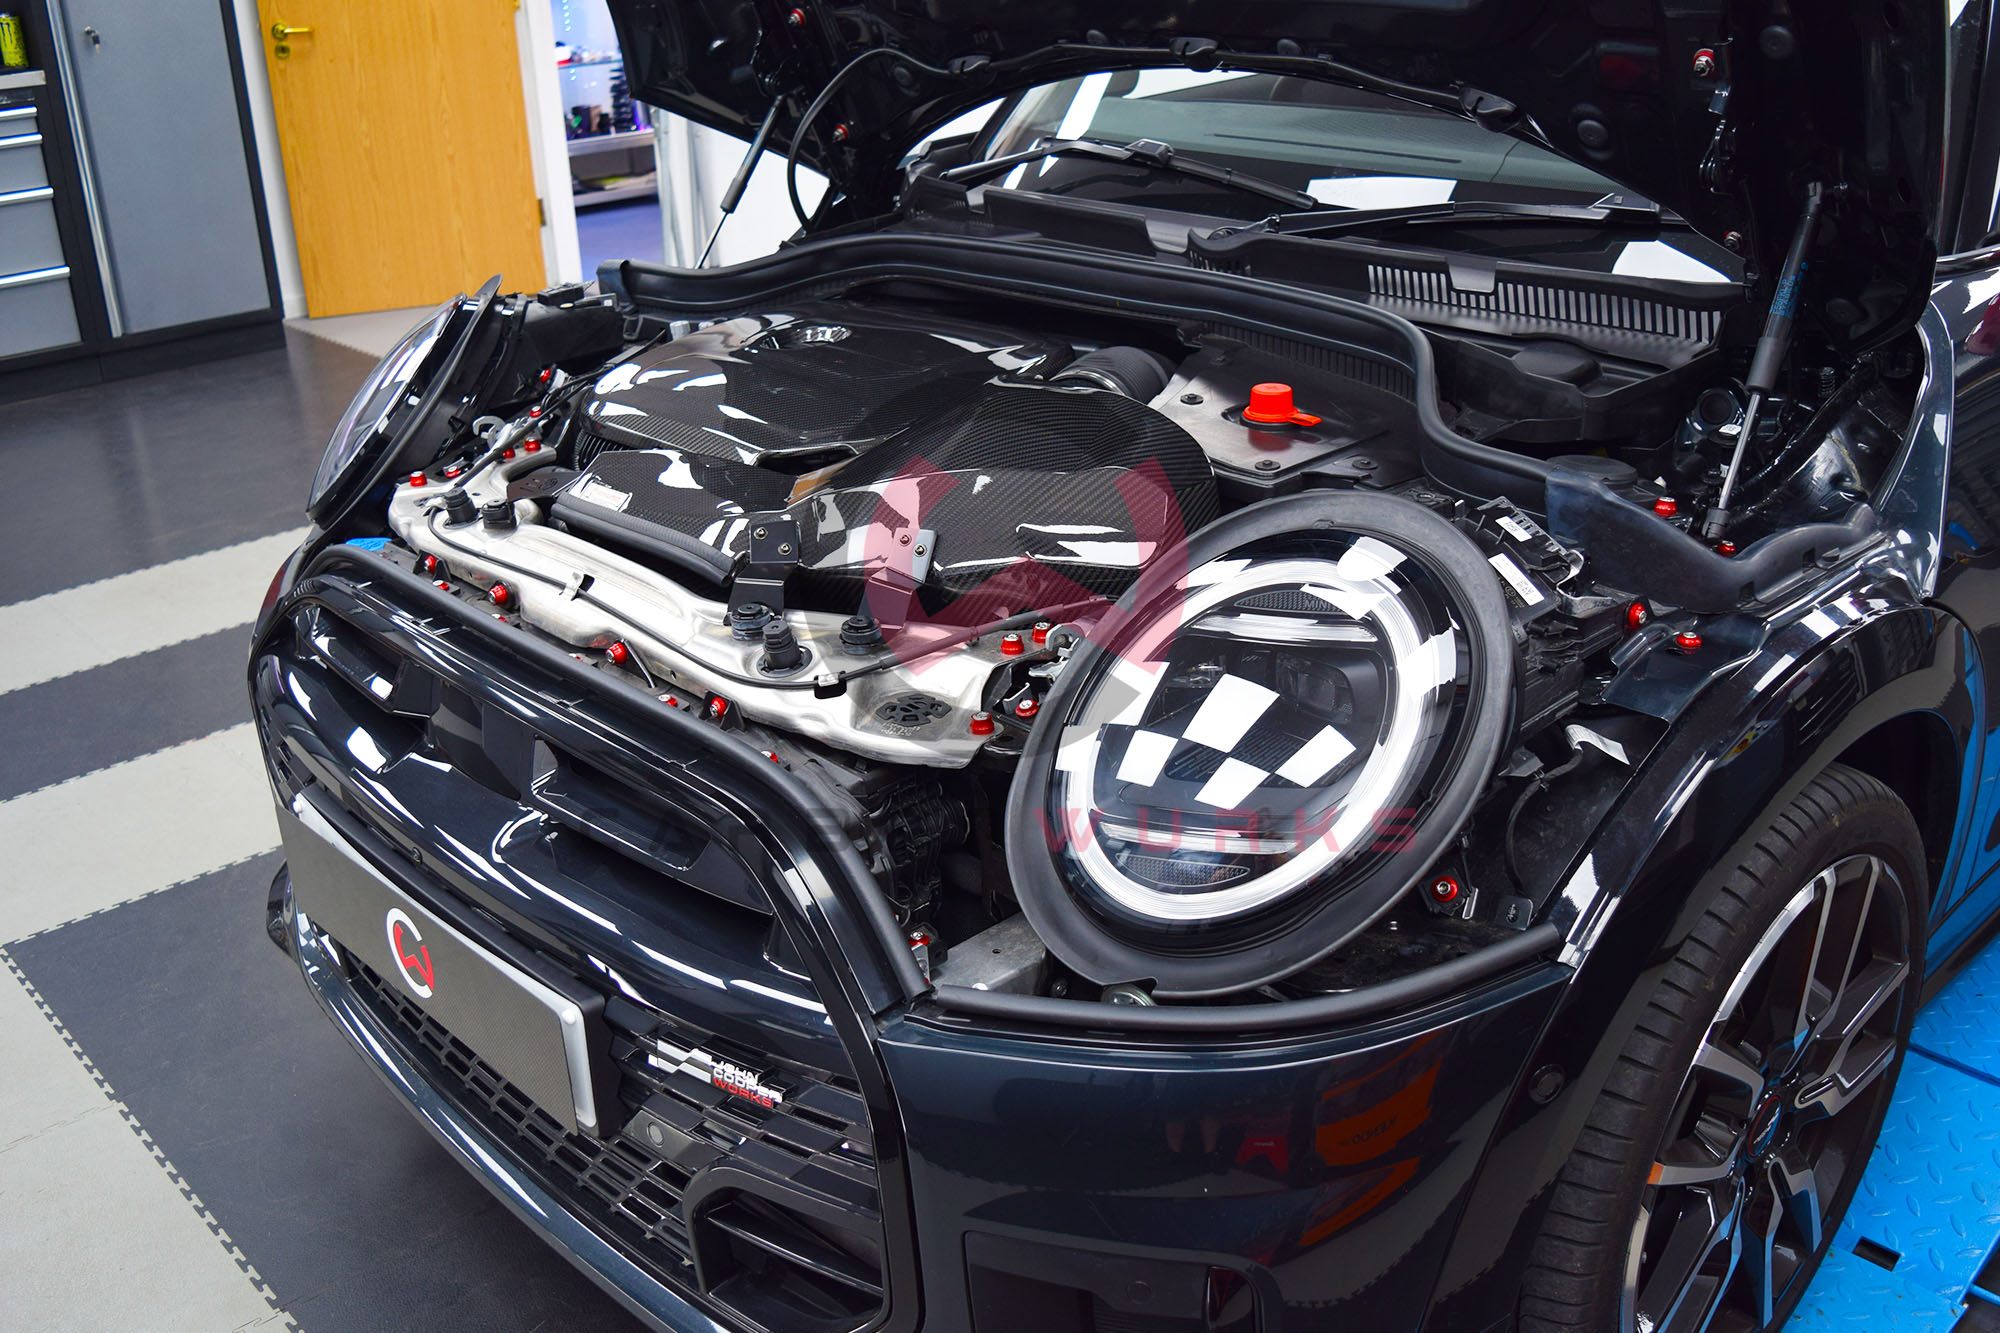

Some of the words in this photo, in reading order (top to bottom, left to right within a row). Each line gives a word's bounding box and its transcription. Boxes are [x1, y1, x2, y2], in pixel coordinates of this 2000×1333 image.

[712, 1061, 759, 1085] JOHN
[713, 1067, 783, 1103] COOPER
[713, 1076, 773, 1108] WORKS
